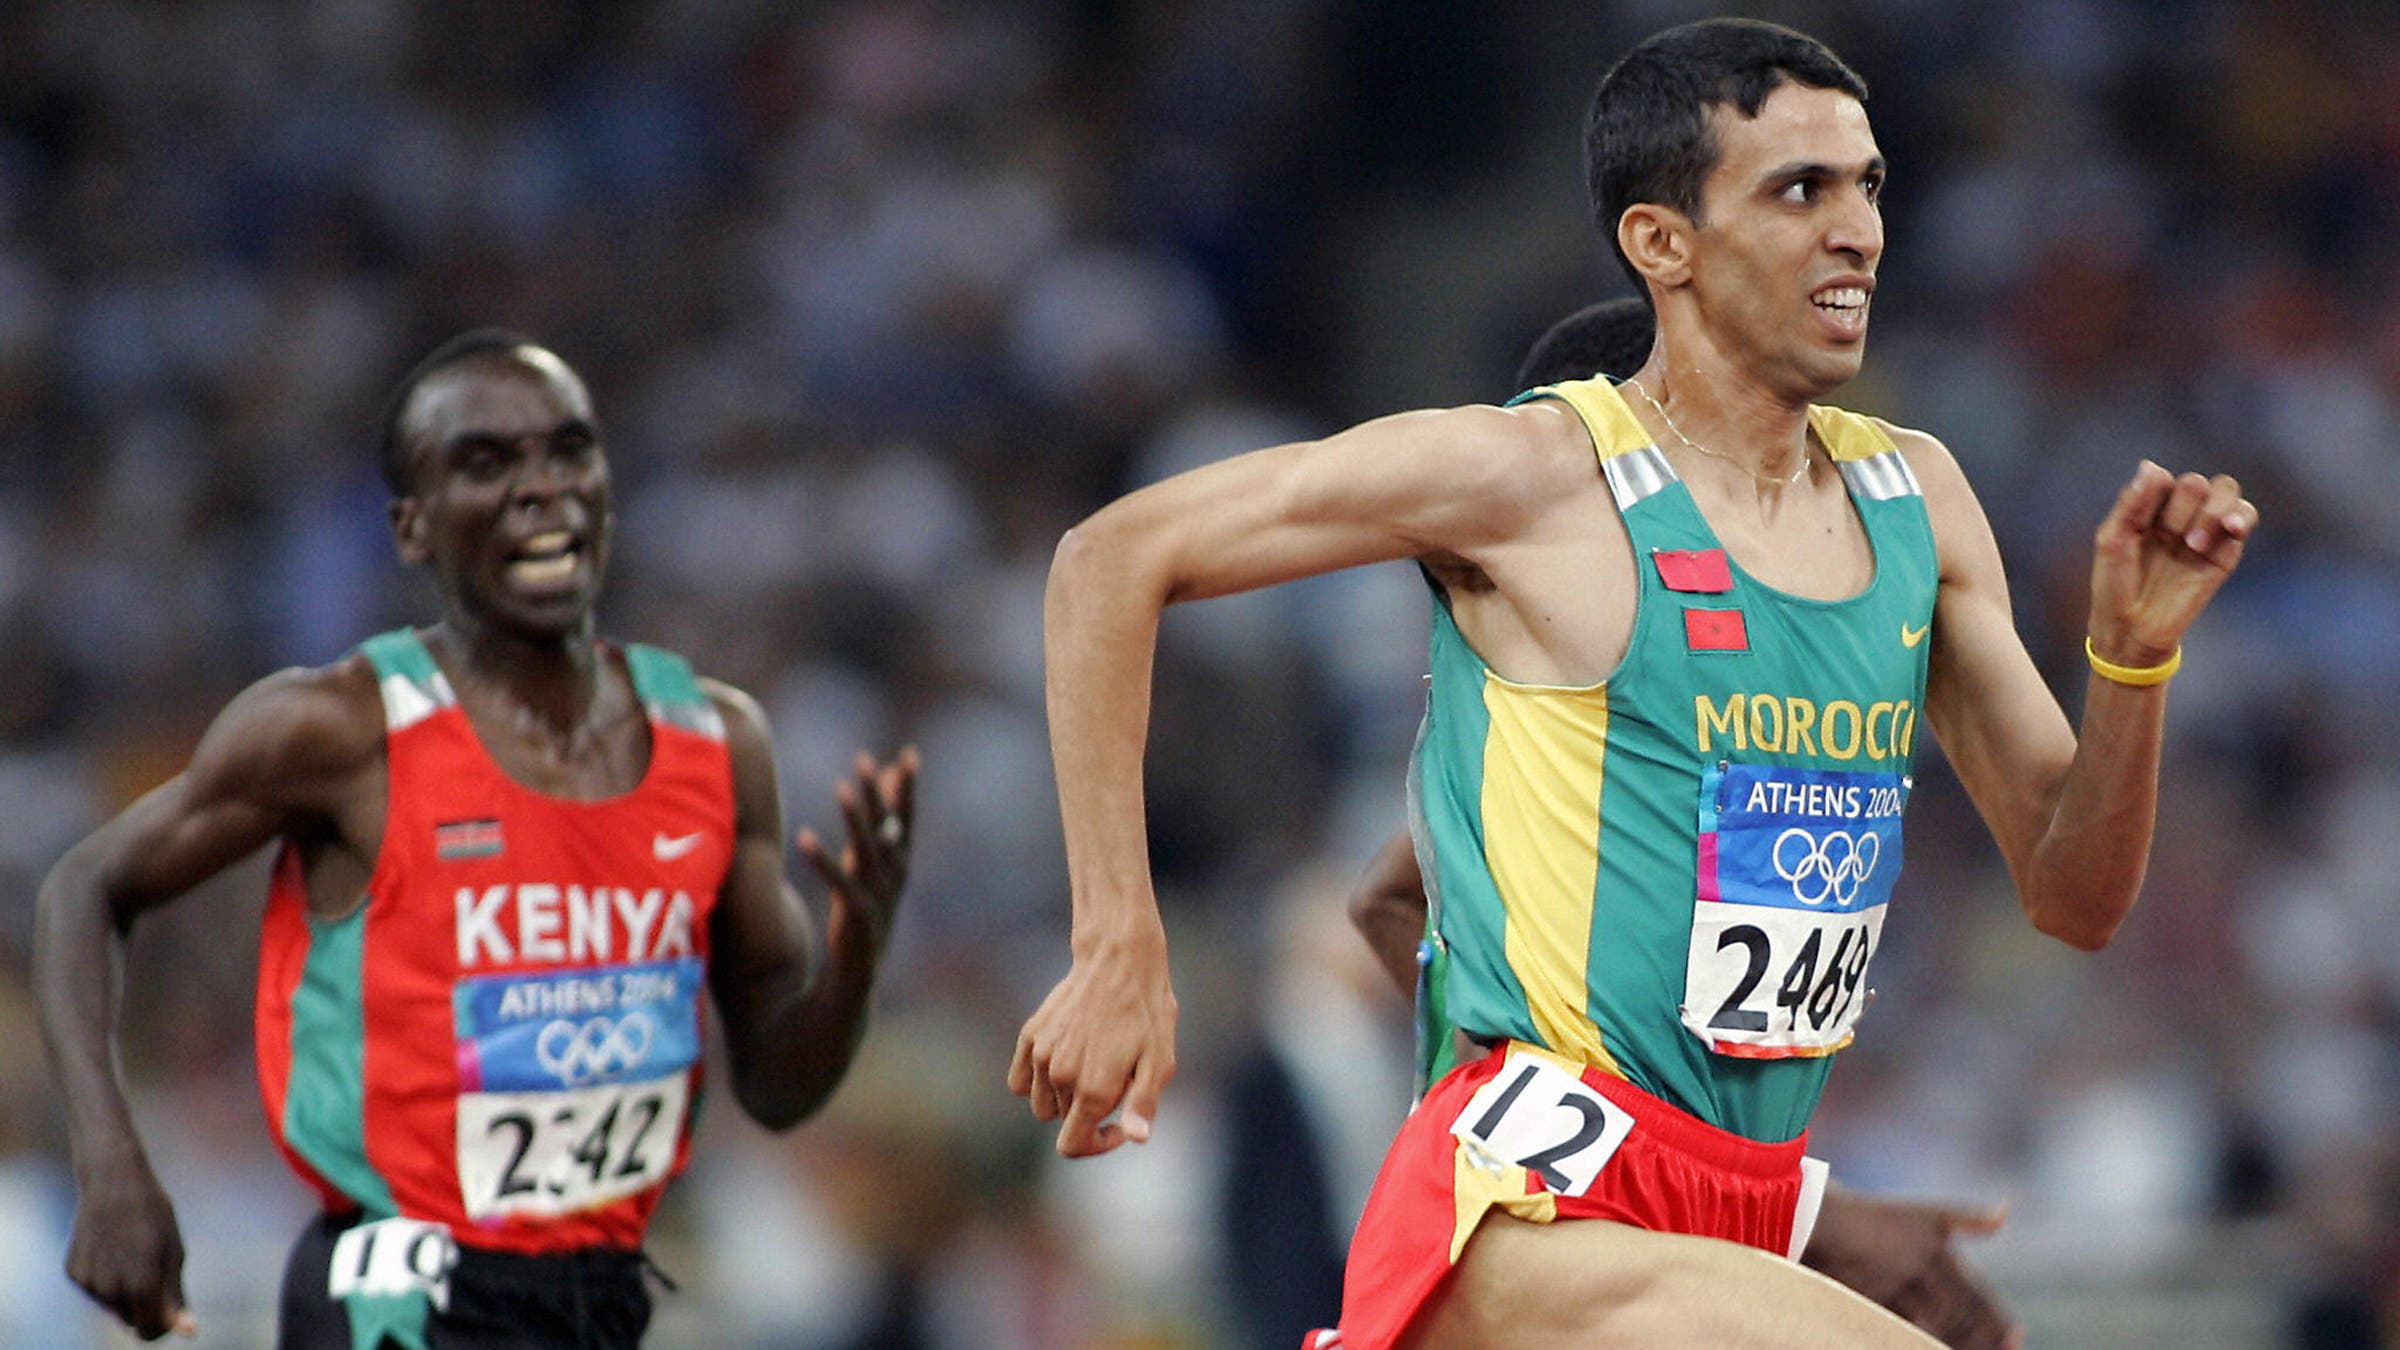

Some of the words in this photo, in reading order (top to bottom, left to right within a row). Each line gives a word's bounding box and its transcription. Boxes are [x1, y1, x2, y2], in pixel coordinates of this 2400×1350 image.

[1746, 781, 1861, 819] ATHENS
[454, 882, 697, 967] KENYA
[499, 976, 617, 1020] ATHENS
[1707, 923, 1869, 1033] 2469
[1471, 1064, 1606, 1194] 12
